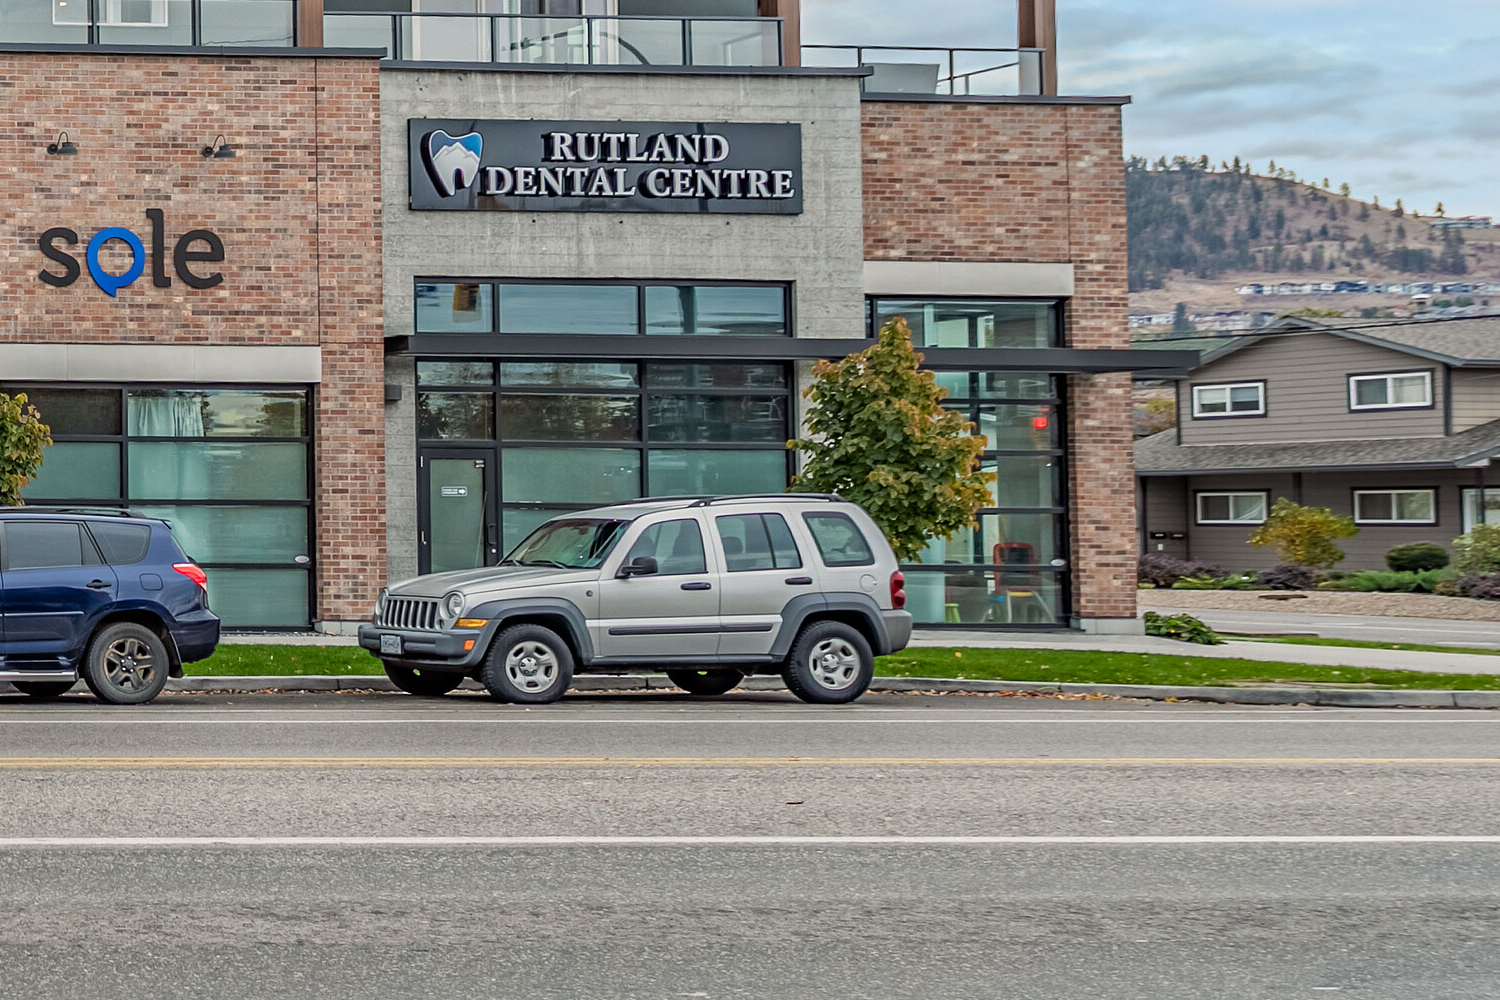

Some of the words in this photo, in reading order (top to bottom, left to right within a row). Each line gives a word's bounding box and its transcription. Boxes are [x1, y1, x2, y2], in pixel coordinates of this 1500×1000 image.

[549, 132, 730, 163] RUTLAND
[485, 166, 637, 196] DENTAL
[645, 168, 795, 198] CENTRE
[38, 208, 225, 297] sole
